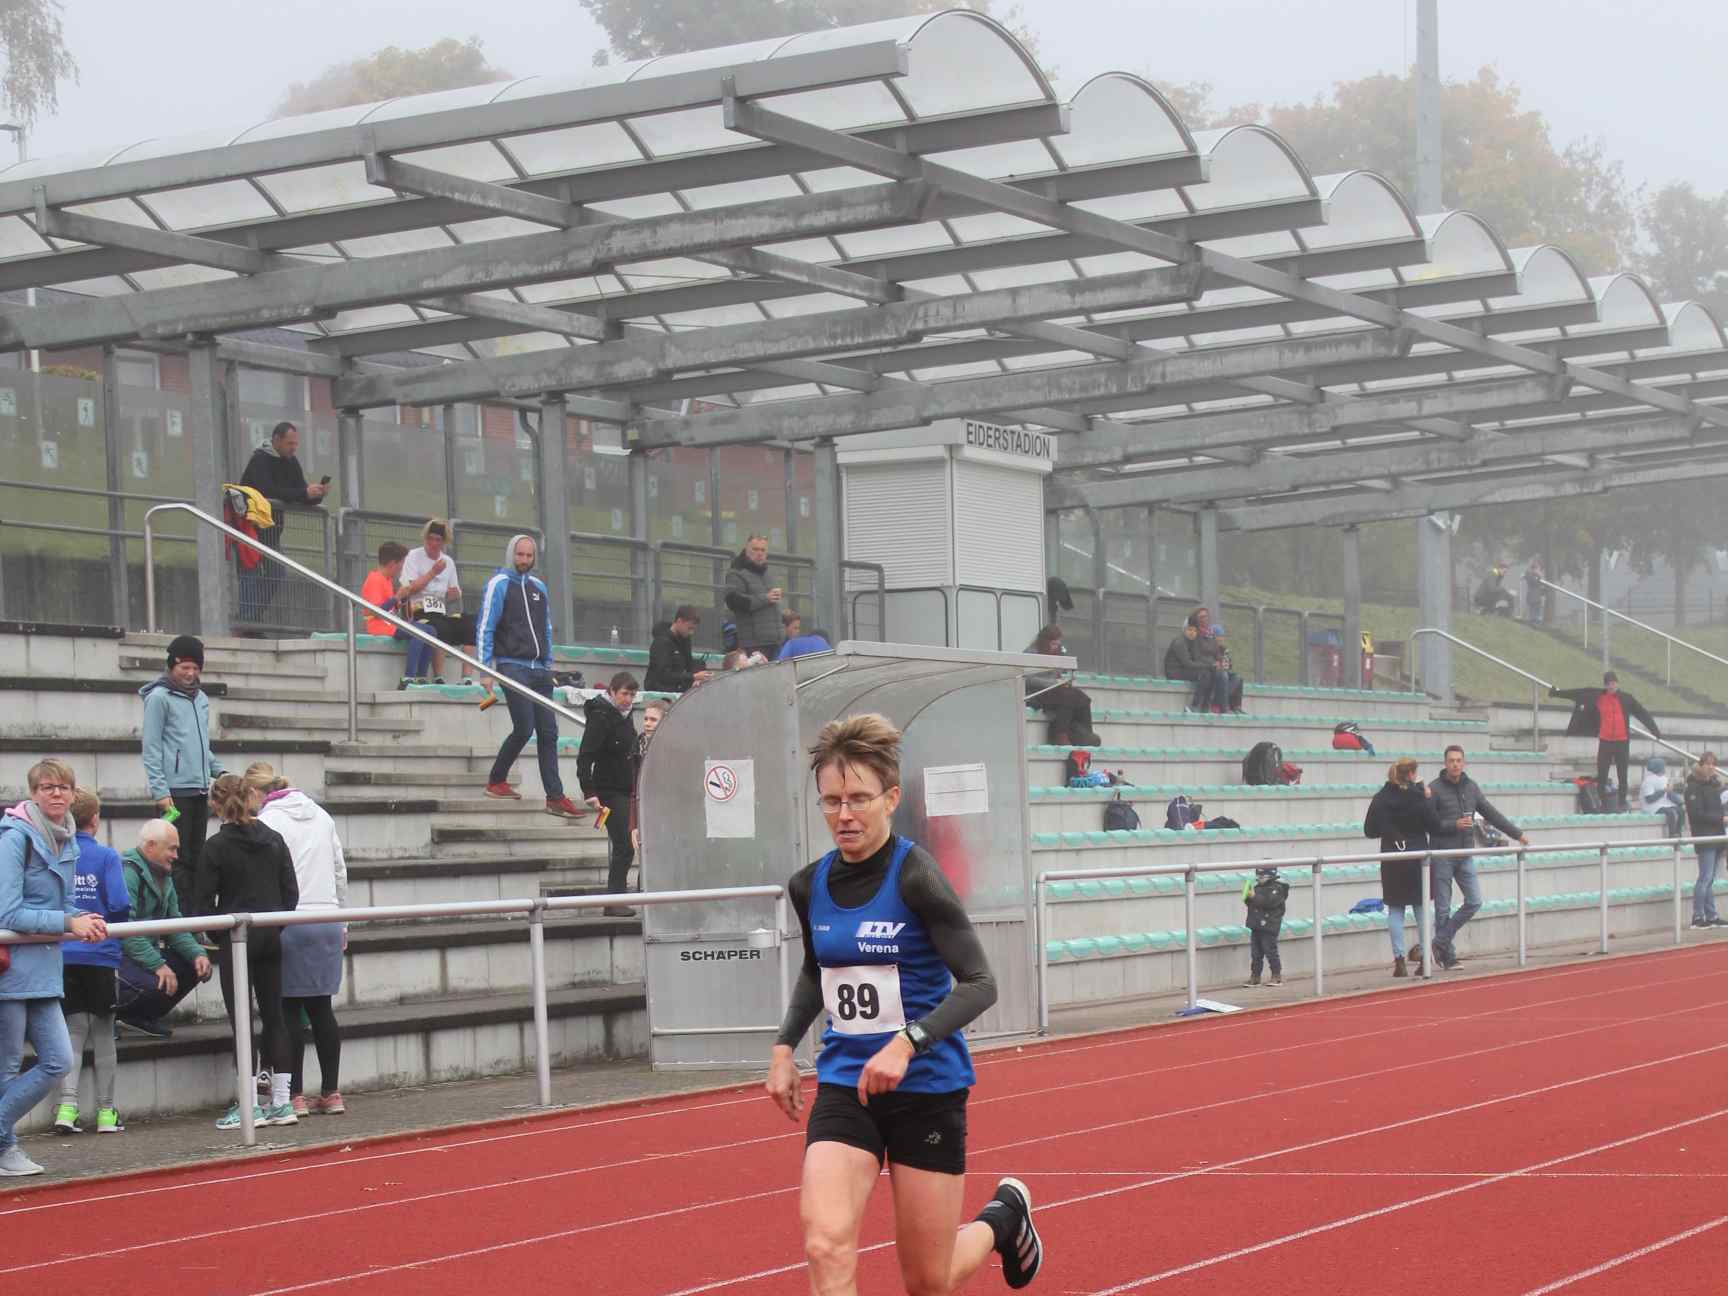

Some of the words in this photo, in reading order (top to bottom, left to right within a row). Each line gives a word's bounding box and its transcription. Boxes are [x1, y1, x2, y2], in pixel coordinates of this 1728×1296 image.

[967, 422, 1050, 458] EIDERSTADION
[857, 941, 899, 953] Verena
[837, 982, 880, 1021] 89
